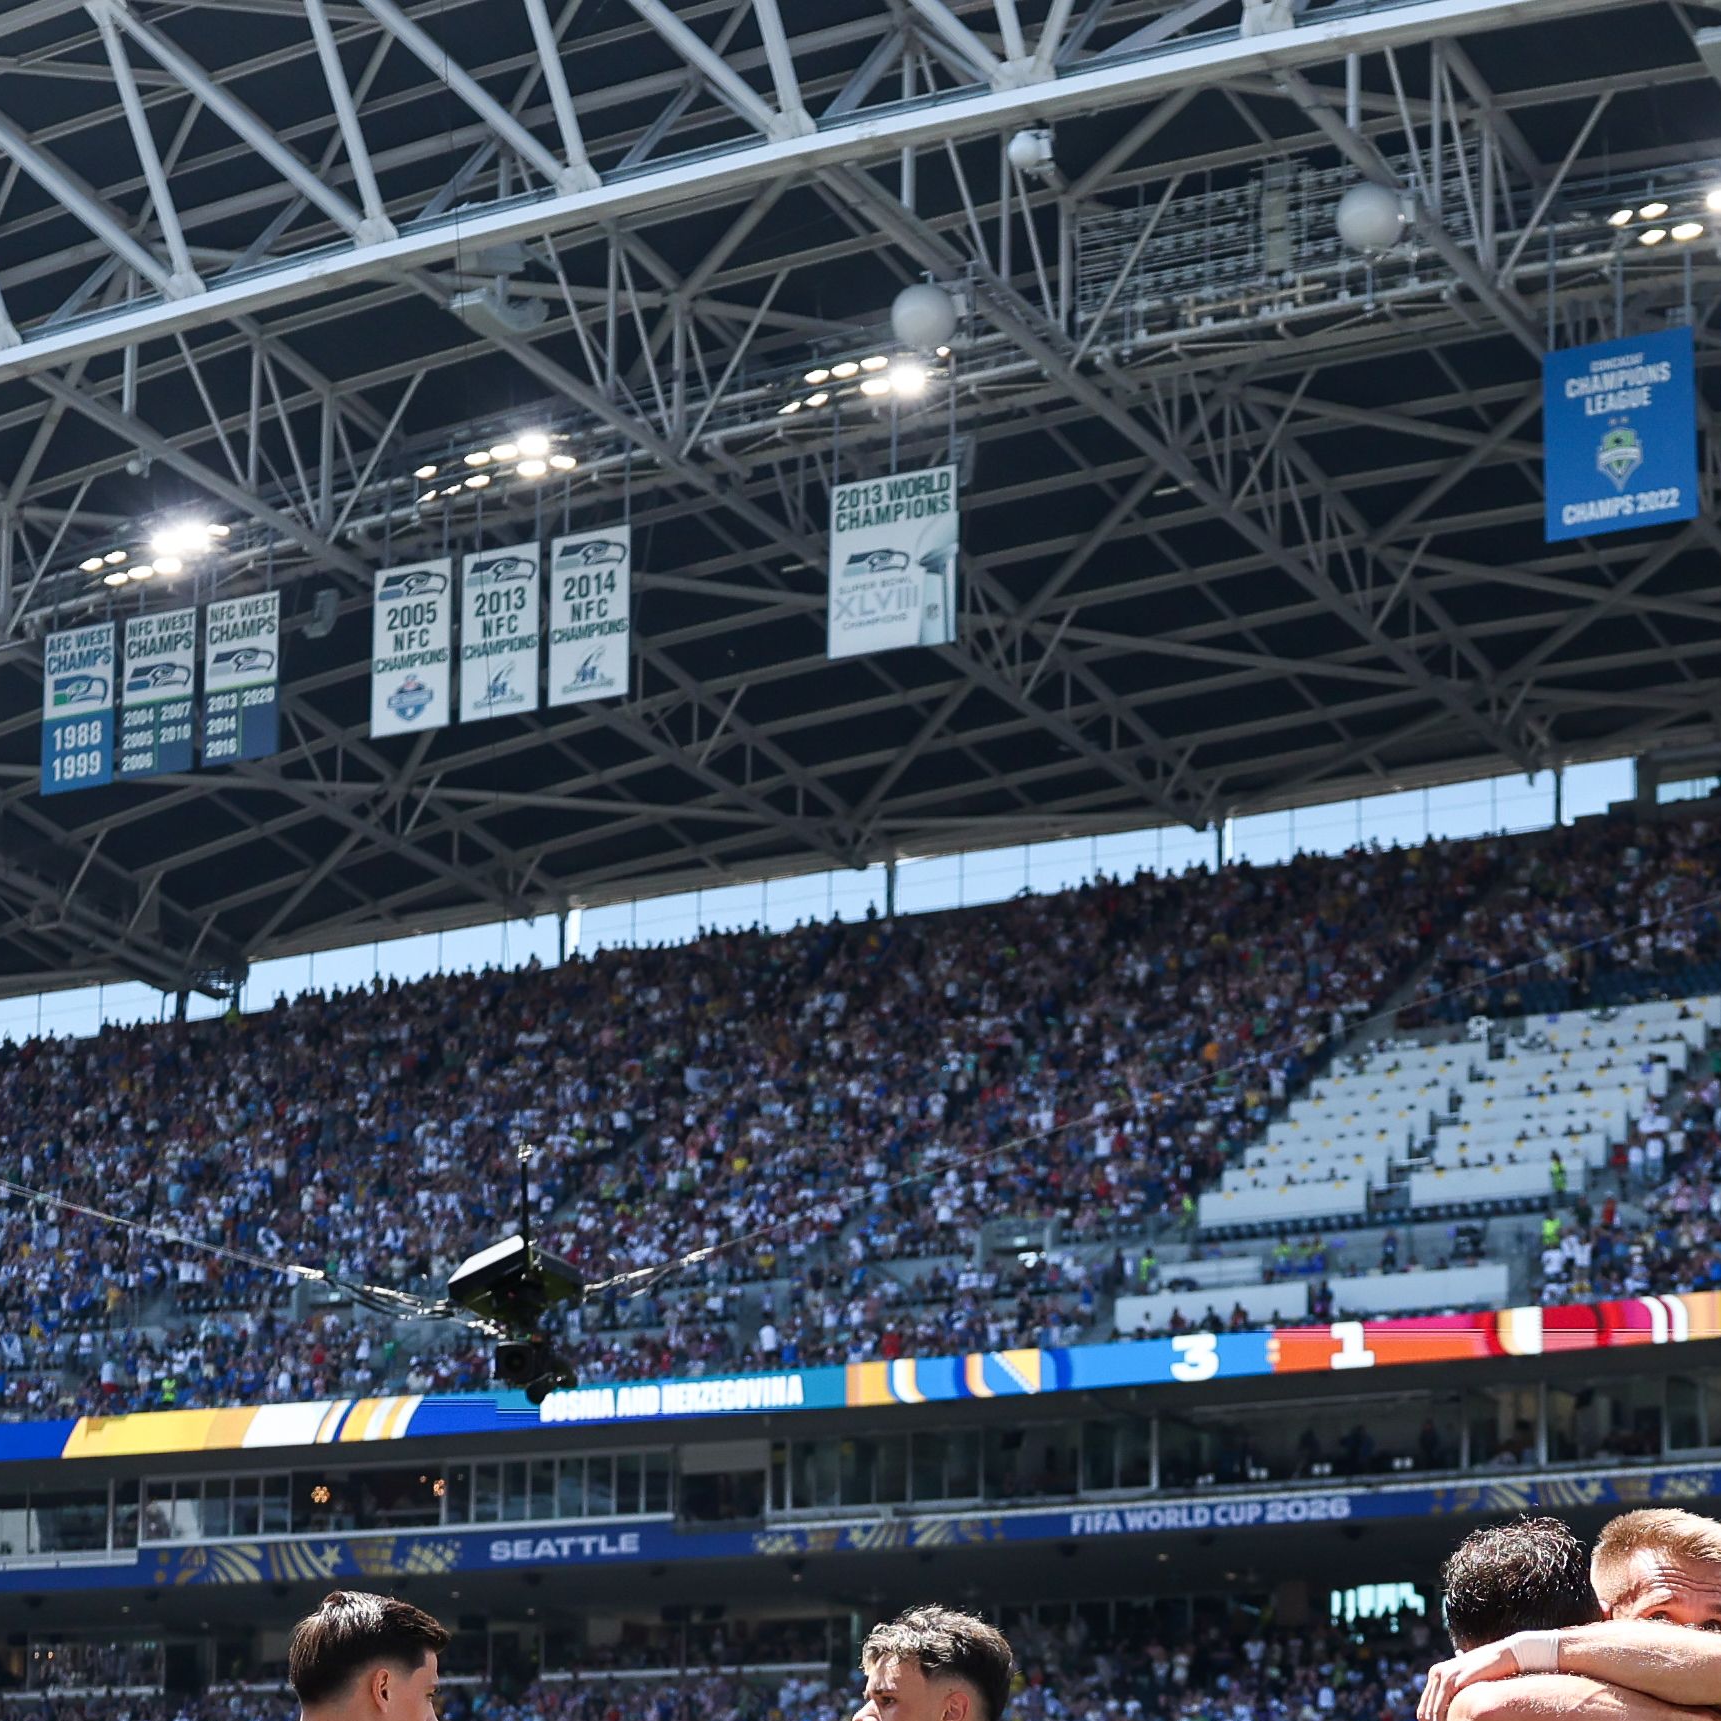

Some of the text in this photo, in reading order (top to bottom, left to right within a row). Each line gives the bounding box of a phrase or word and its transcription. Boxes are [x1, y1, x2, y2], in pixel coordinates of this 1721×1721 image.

[1565, 361, 1671, 399] CHAMPIONS
[1584, 386, 1652, 416] LEAGUE
[836, 471, 951, 512] 2013 WORLD
[1562, 487, 1681, 525] CHAMPS 2022
[836, 494, 952, 533] CHAMPIONS
[563, 570, 616, 601] 2014
[210, 596, 278, 623] NFC WEST
[387, 601, 437, 631] 2005
[474, 586, 527, 618] 2013
[571, 598, 609, 623] NFC
[834, 585, 919, 623] XLVIII
[47, 628, 113, 653] AFC WEST
[129, 613, 193, 638] NFC WEST
[209, 615, 276, 644] CHAMPS
[394, 628, 430, 652] NFC
[481, 615, 518, 639] NFC
[551, 616, 629, 645] CHAMPIONS
[128, 631, 193, 660] CHAMPS
[462, 632, 538, 662] CHAMPIONS
[47, 647, 112, 675] CHAMPS
[374, 647, 450, 675] CHAMPIONS
[52, 720, 103, 752] 1988
[51, 750, 102, 782] 1999
[1169, 1333, 1220, 1383] 3
[1330, 1320, 1375, 1370] 1
[1070, 1497, 1352, 1536] FIFA WORLD CUP 2026
[489, 1531, 641, 1563] SEATTLE
